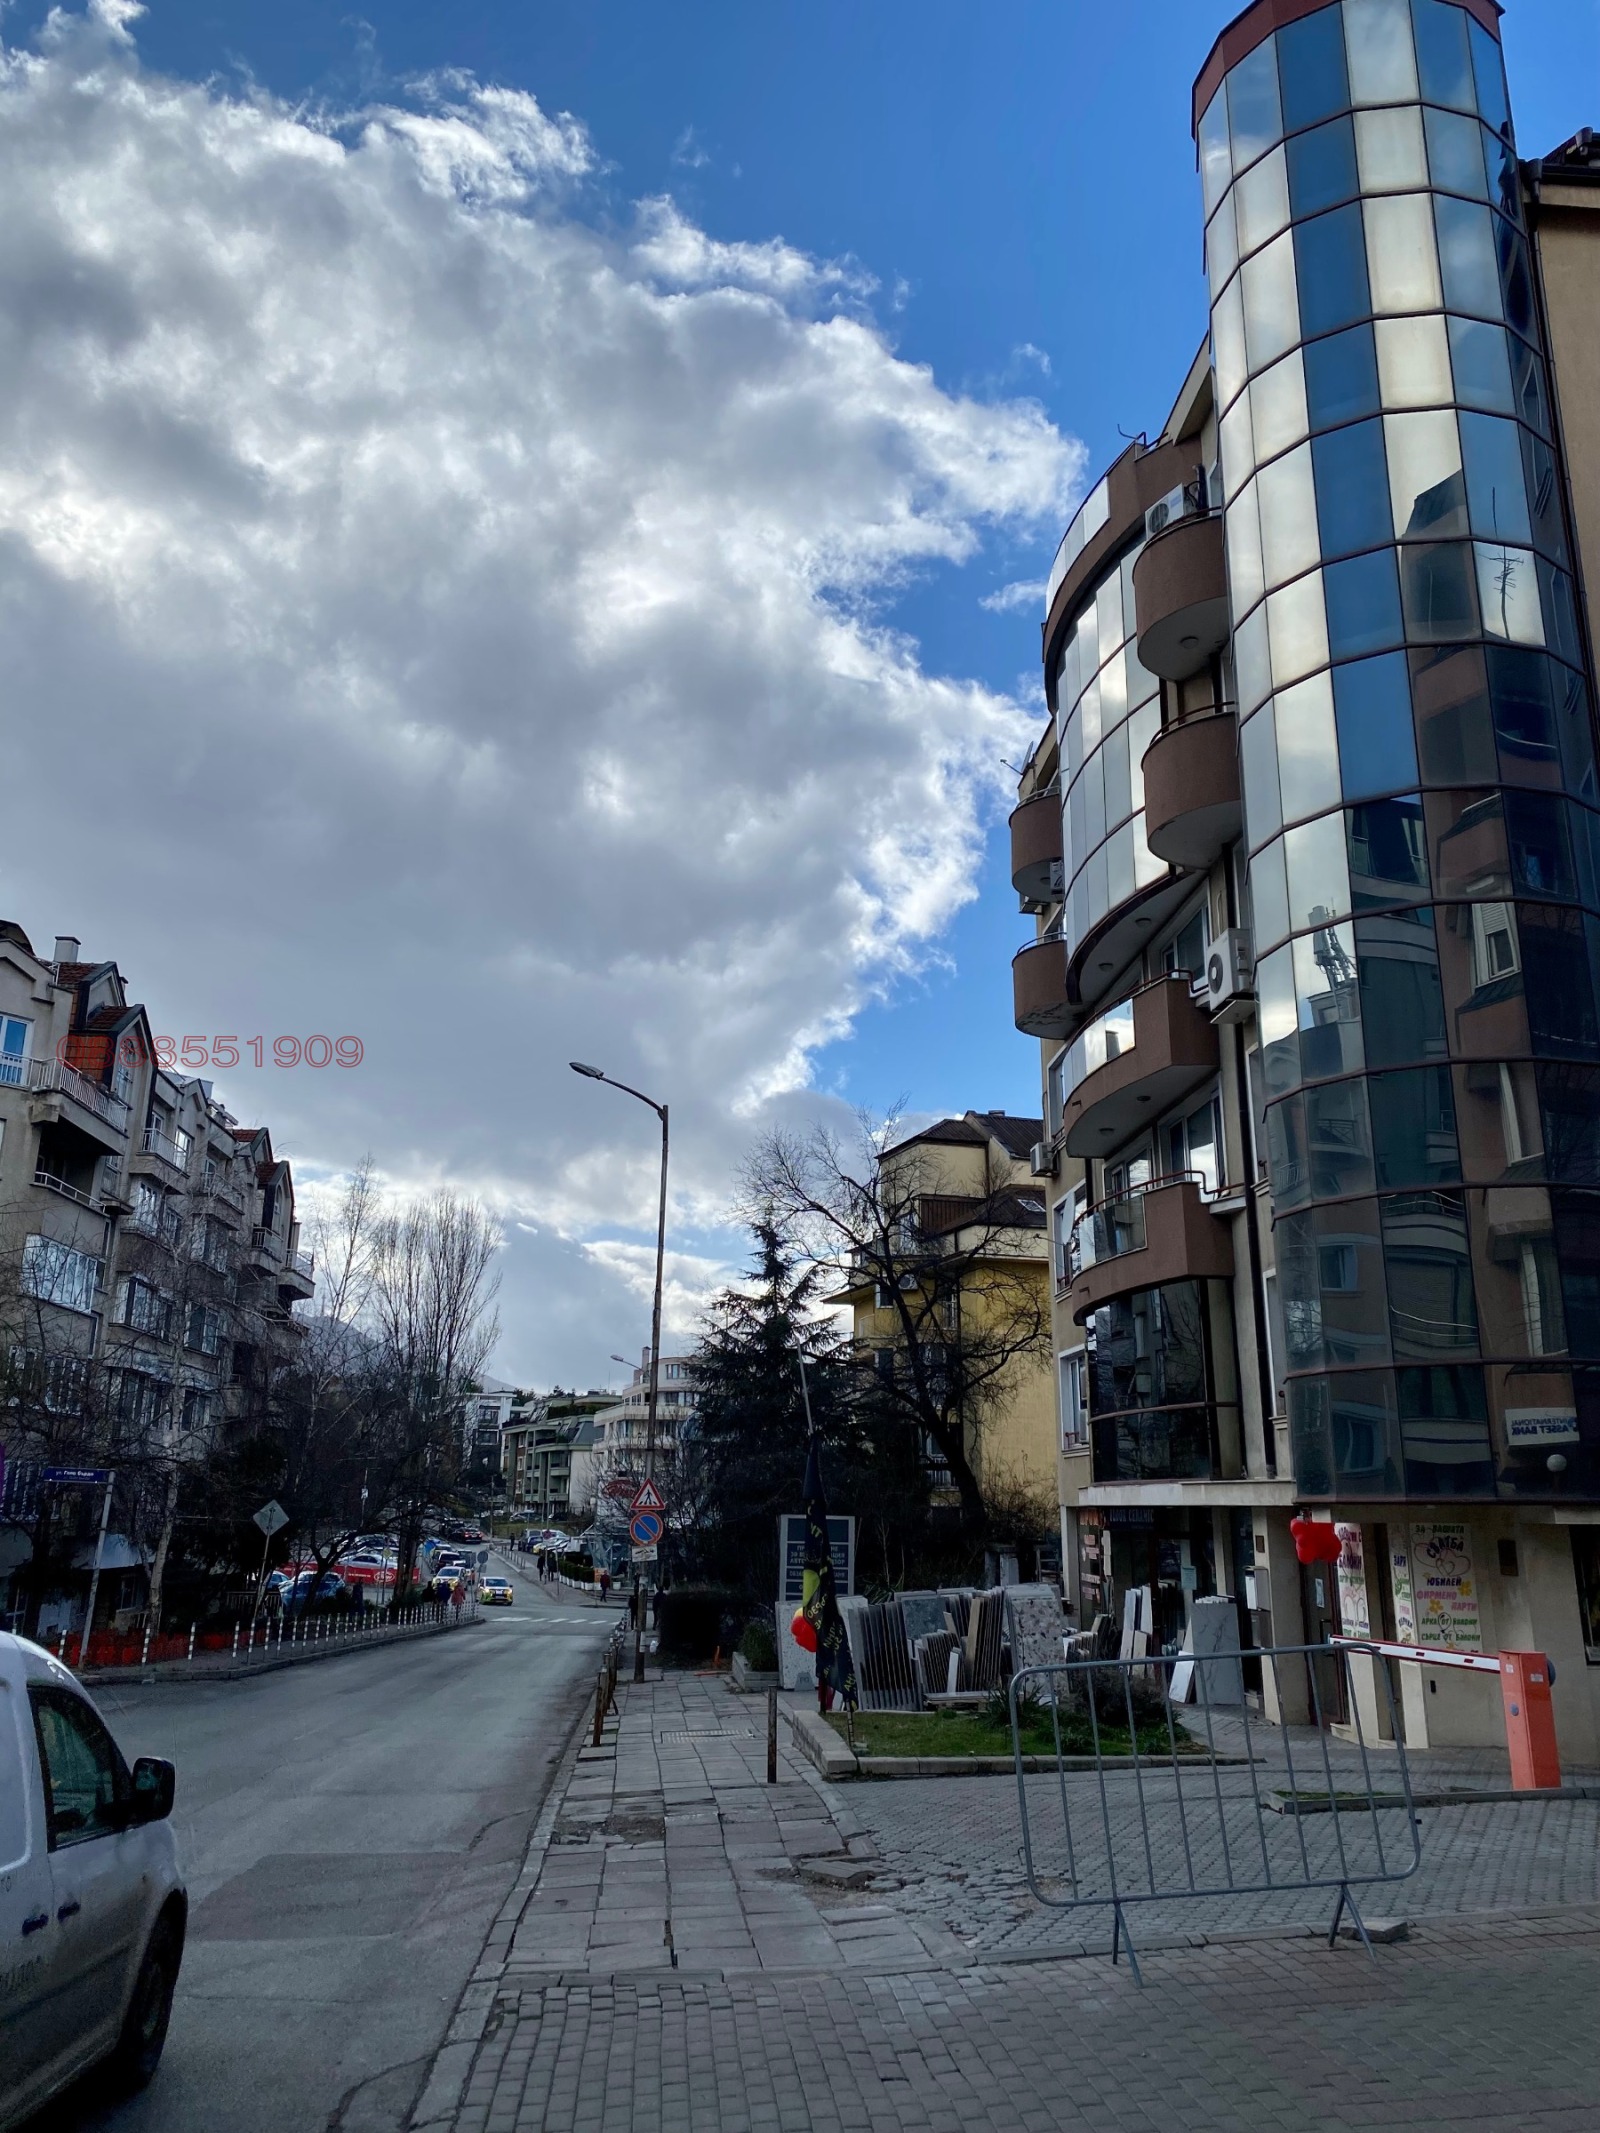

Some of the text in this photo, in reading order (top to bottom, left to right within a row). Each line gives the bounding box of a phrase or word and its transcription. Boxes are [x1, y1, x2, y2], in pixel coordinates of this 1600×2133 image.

[1427, 1536, 1465, 1559] СВАТБА
[1427, 1577, 1462, 1586] ЮБИЛЕЙ
[1416, 1590, 1457, 1600] ФИРМЕНО
[1451, 1602, 1478, 1611] ПАРТИ
[1453, 1618, 1478, 1626] БАЛОНИ
[1456, 1634, 1481, 1642] БАЛОНИ
